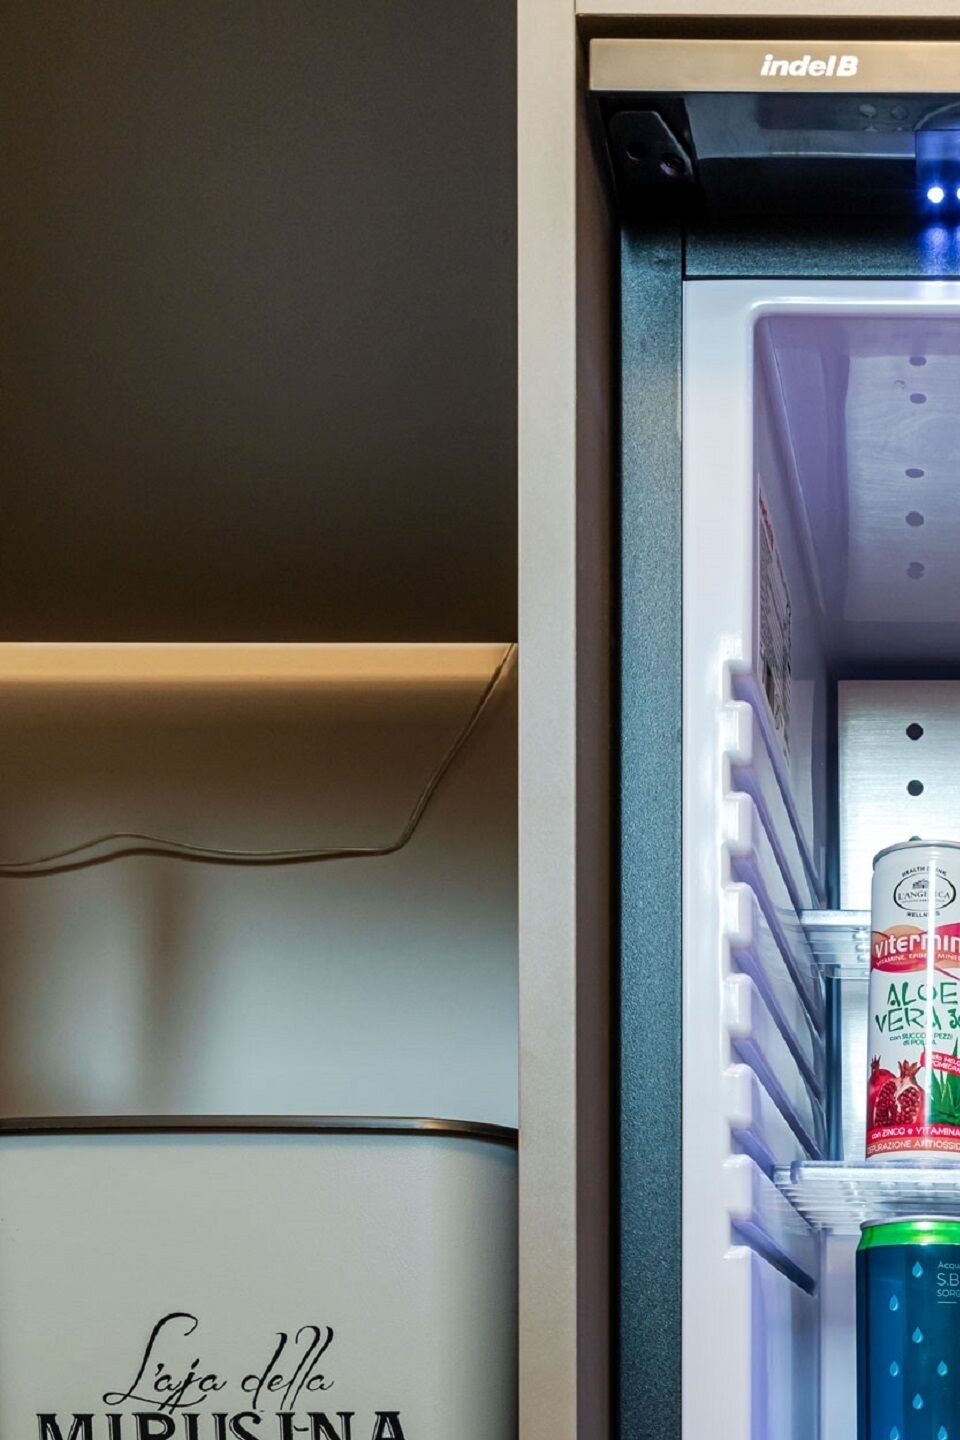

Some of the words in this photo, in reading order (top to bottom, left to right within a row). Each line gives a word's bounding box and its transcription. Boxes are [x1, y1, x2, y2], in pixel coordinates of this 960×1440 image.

[887, 981, 958, 1007] ALOE
[875, 1007, 941, 1033] VERA
[882, 1127, 905, 1137] ZINCO
[241, 1326, 334, 1411] della
